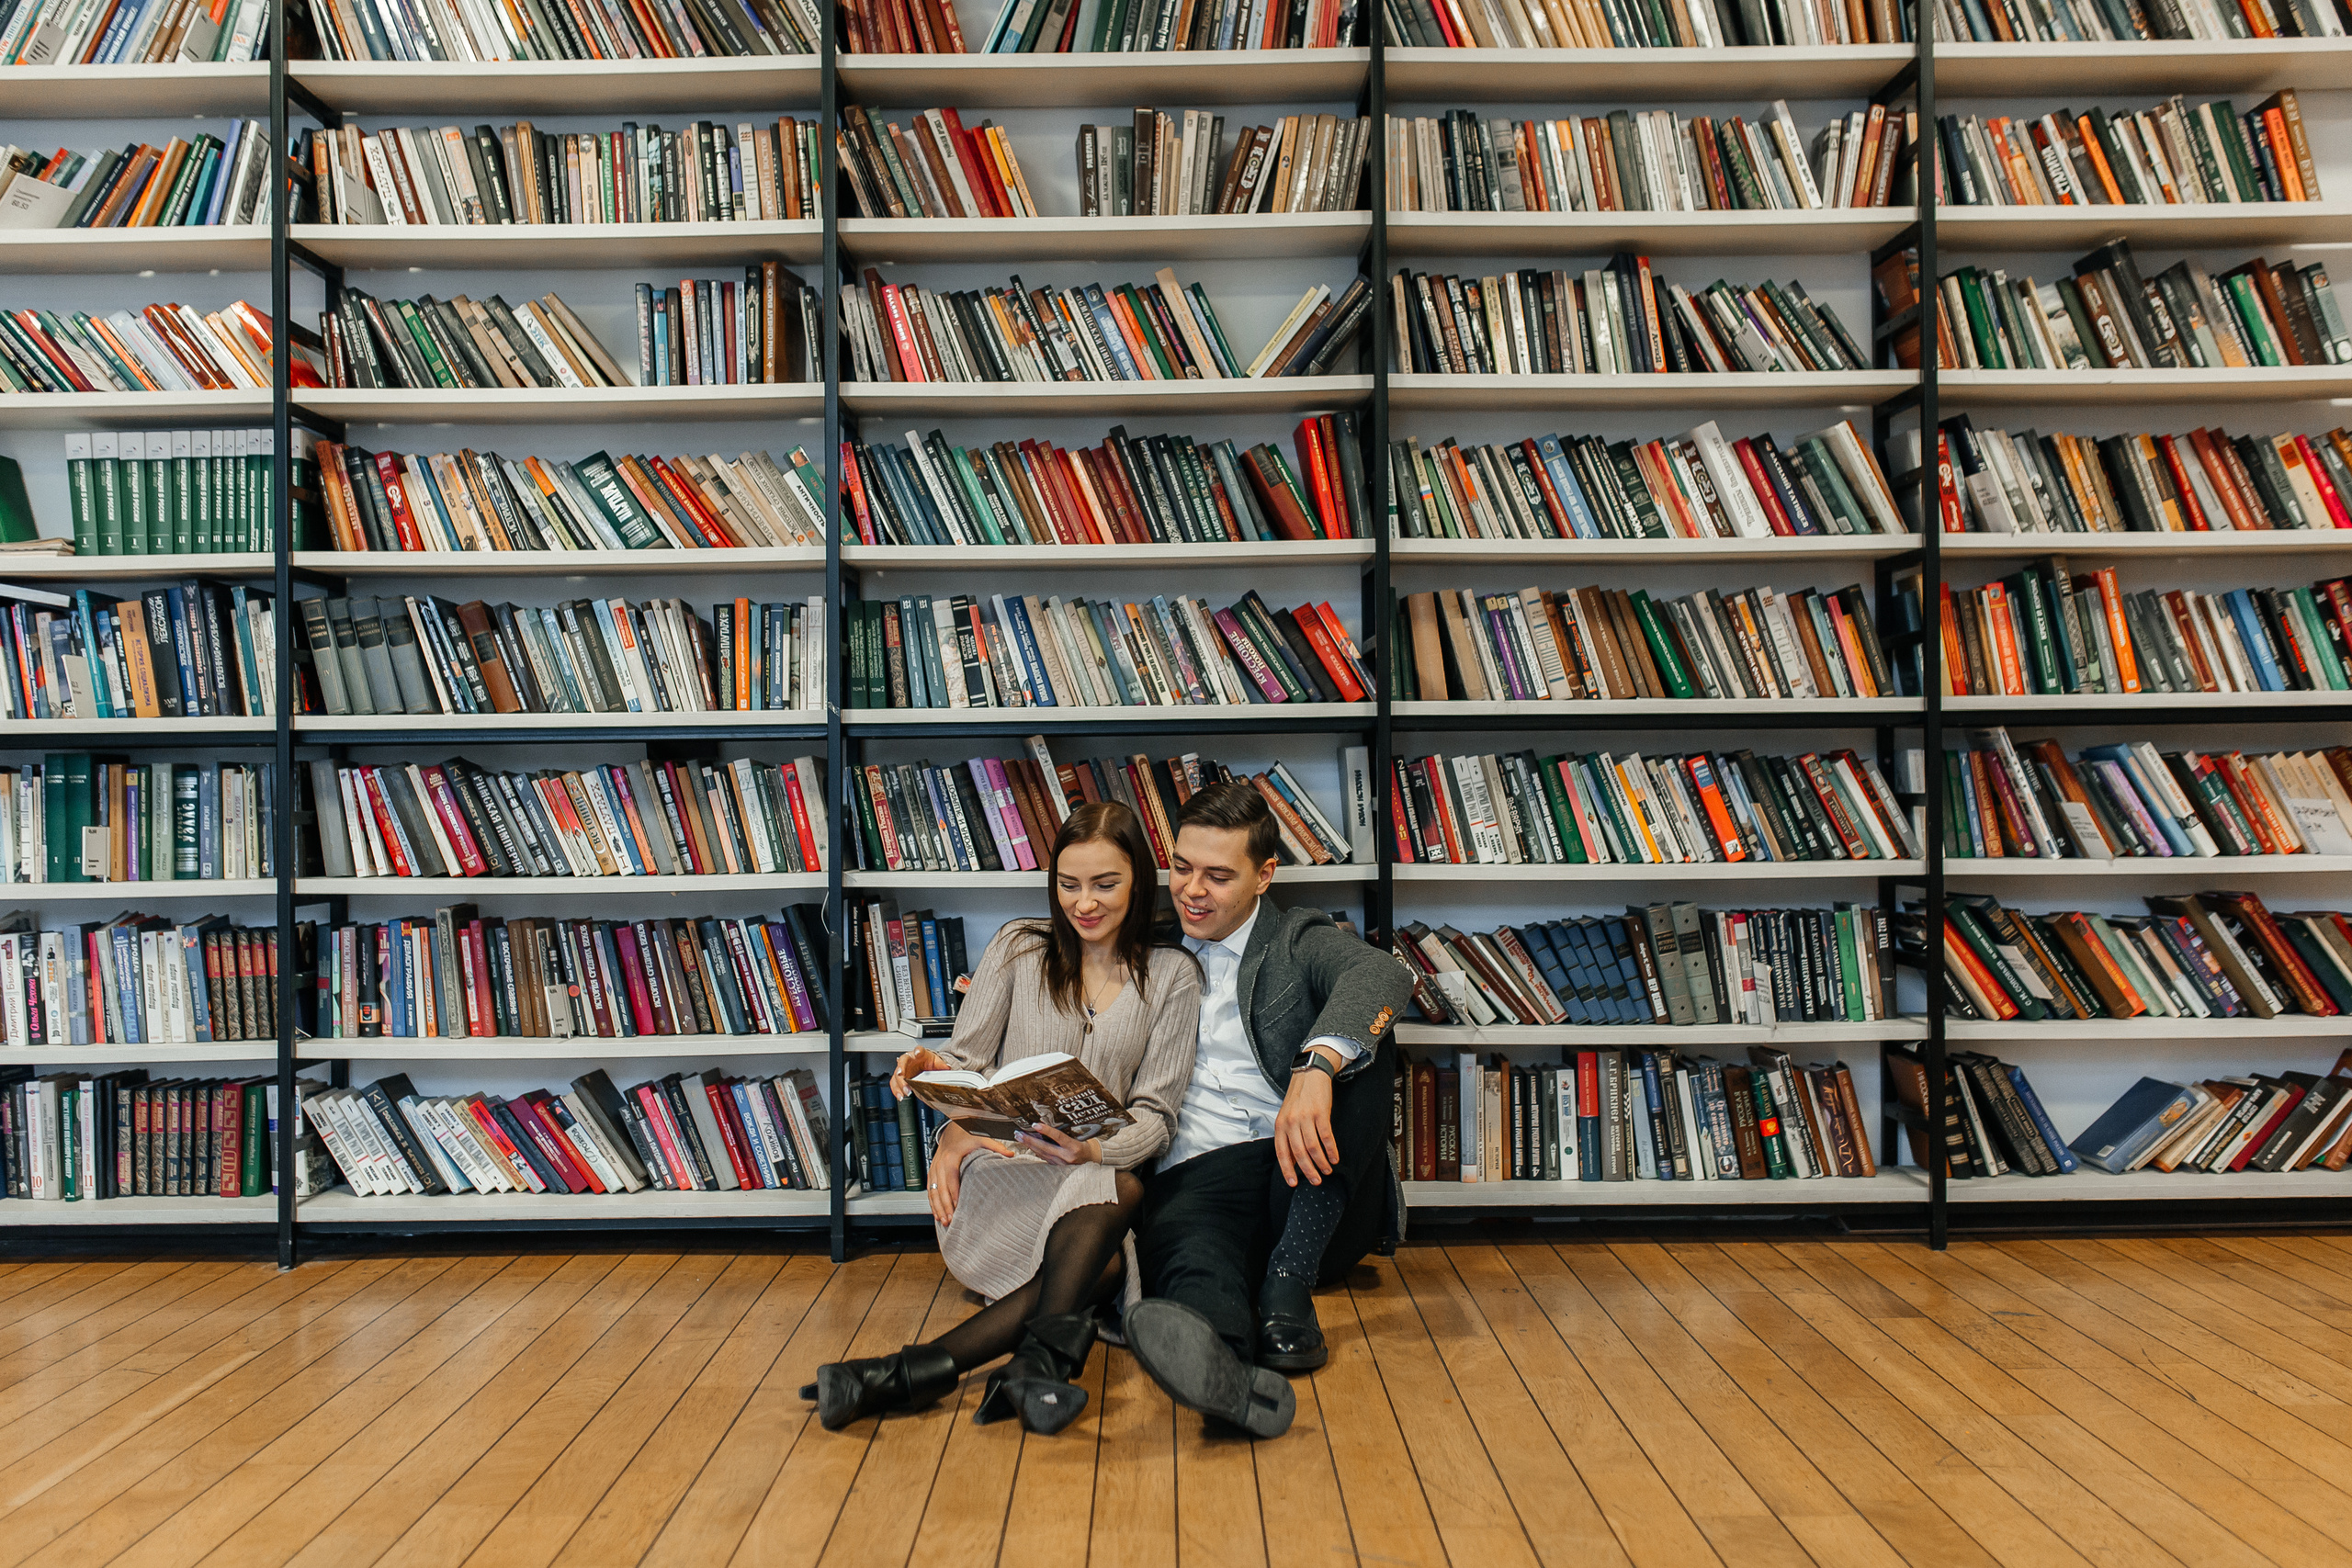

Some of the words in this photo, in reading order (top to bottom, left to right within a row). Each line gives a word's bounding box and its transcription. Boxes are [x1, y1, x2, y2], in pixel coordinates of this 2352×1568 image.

[486, 154, 496, 171] РИМ
[760, 136, 769, 169] ВОСТОК
[1084, 133, 1093, 167] РАВЕЛИН
[369, 145, 392, 198] ПЛУТАРХ
[2039, 145, 2071, 195] СТАЛИНА
[491, 176, 505, 209] ДРЕВНИЙ
[705, 173, 714, 206] ДРЕВНИЙ
[763, 180, 773, 214] РОССИЯ
[1142, 299, 1158, 326] документов
[1153, 325, 1167, 346] Сборник
[77, 461, 86, 491] МИГРАЦИЯ
[104, 460, 113, 491] МИГРАЦИЯ
[130, 461, 139, 492] МИГРАЦИЯ
[747, 459, 763, 480] ВЕКОВ
[762, 457, 776, 475] ВЕКОВ
[1190, 454, 1206, 486] МАЗЕПА
[660, 468, 688, 502] ДЕМОКРАТИЯ
[760, 478, 780, 505] СРЕДНИХ
[773, 475, 793, 502] СРЕДНИХ
[1404, 475, 1417, 510] ПИРОГОВ
[1768, 451, 1790, 488] ВАСИЛИЙ
[1786, 489, 1809, 528] ТАТИЩЕВ
[80, 499, 89, 521] РОССИИ
[106, 498, 115, 520] РОССИИ
[341, 483, 358, 530] АНТИЧНОСТЬ
[600, 480, 633, 522] ПЛУТАРХ
[684, 501, 705, 525] АНТИЧНАЯ
[735, 488, 776, 542] ЖИЗНЕОПИСАНИЯ
[790, 502, 810, 528] ИСТОРИЯ
[796, 483, 826, 528] АНТИЧНОСТЬ
[498, 501, 518, 533] ИСТОРИЯ
[778, 507, 797, 532] ИСТОРИЯ
[1623, 500, 1646, 539] РОССИЯ
[2029, 578, 2042, 608] КОРОНА
[148, 596, 161, 644] ИСТОРИЧЕСКИЙ
[154, 595, 168, 643] ЛЕКСИКОН
[1240, 610, 1263, 641] РОССИЙСКОГО
[1639, 598, 1659, 632] РОССИЙСКОГО
[2038, 618, 2048, 639] КРЕСТ
[173, 618, 188, 666] ХРЕСТОМАТИЯ
[719, 617, 729, 648] ПЛУТАРХ
[1158, 630, 1175, 665] ПЕРИКЛ
[1655, 631, 1672, 660] ГОСУДАРСТВА
[134, 638, 145, 665] ИСТОРИЯ
[1228, 630, 1267, 685] КРЕСТОВЫЕ
[1240, 635, 1265, 669] ПОХОДЫ
[1260, 640, 1282, 670] ГОСУДАРСТВА
[139, 667, 151, 706] СОЦИАЛИЗМА
[1030, 661, 1043, 683] ИСТОРИЯ
[1280, 670, 1295, 690] ИСТОРИЯ
[1668, 660, 1683, 683] ИСТОРИЯ
[1036, 683, 1049, 701] НОВАЯ
[1257, 776, 1280, 802] КУЛЬТУРЫ
[1354, 769, 1364, 801] ИСТОРИЯ
[1530, 772, 1542, 790] ВОЙНЕ
[1546, 764, 1561, 795] ИЗГНАНИИ
[1604, 756, 1627, 806] ПРОТИВОСТОЯНИЕ
[2022, 757, 2042, 791] ЗВЕНЬЯ
[459, 785, 478, 818] ХРИСТОС
[589, 781, 617, 835] ПЛУТАРХ
[946, 783, 963, 819] ЭШАФОТ
[1274, 800, 1298, 826] РУССКОЙ
[1357, 802, 1366, 826] НОВАЯ
[1535, 790, 1550, 815] МИРОВОЙ
[472, 774, 502, 823] РИМСКАЯ
[495, 823, 525, 874] ИМПЕРИЯ
[573, 795, 607, 855] СВЕТОНИЙ
[876, 805, 887, 829] России
[1543, 814, 1554, 832] ВТОРОЙ
[1558, 803, 1573, 832] ТРОЦКИЙ
[476, 826, 493, 856] ЦЕЗАРЬ
[882, 831, 894, 858] История
[961, 831, 975, 858] КОРОНА
[1294, 824, 1317, 849] ИСТОРИЯ
[1548, 832, 1557, 841] ВО
[1551, 841, 1564, 860] СССР
[579, 924, 590, 946] ВЕКОВ
[636, 923, 648, 945] ВЕКОВ
[1877, 917, 1886, 931] 1812
[798, 939, 813, 970] ТИБЕТЕ
[1878, 933, 1888, 948] ГОД
[130, 944, 139, 973] БРОДЕЛЬ
[403, 939, 413, 998] ДЕМОГРАФИЯ
[584, 947, 596, 978] СРЕДНИХ
[642, 946, 655, 976] СРЕДНИХ
[5, 960, 15, 990] Быков
[343, 966, 352, 1001] НОВЕЙШАЯ
[776, 948, 802, 1008] КРЕСТОВЫЕ
[811, 982, 822, 998] ВСЕ
[894, 965, 903, 988] СИНЕГО
[1646, 978, 1659, 992] ПЕТР
[27, 978, 37, 1006] Чехова
[171, 981, 179, 1009] Народы
[590, 979, 603, 1009] ИСТОРИЯ
[648, 977, 662, 1007] ИСТОРИЯ
[898, 990, 906, 1011] НЕБА
[903, 978, 912, 1010] ВЕЧНОГО
[6, 996, 19, 1038] Дмитрий
[29, 1006, 39, 1030] Ольга
[122, 990, 137, 1040] ТАЙНЫ
[1055, 1089, 1096, 1106] Летний
[1058, 1094, 1107, 1114] сад
[1066, 1103, 1108, 1120] Петра
[1733, 1090, 1746, 1127] РУССКАЯ
[1742, 1089, 1754, 1126] ИСТОРИЯ
[381, 1108, 405, 1142] ХРИСТОС
[1073, 1109, 1114, 1125] Великого
[1717, 1112, 1727, 1146] великого
[405, 1147, 425, 1175] ЦЕЗАРЬ
[742, 1111, 757, 1137] ВОЖДИ
[755, 1148, 773, 1186] СОВЕТНИКИ
[32, 1176, 42, 1187] 10
[84, 1175, 94, 1186] 11
